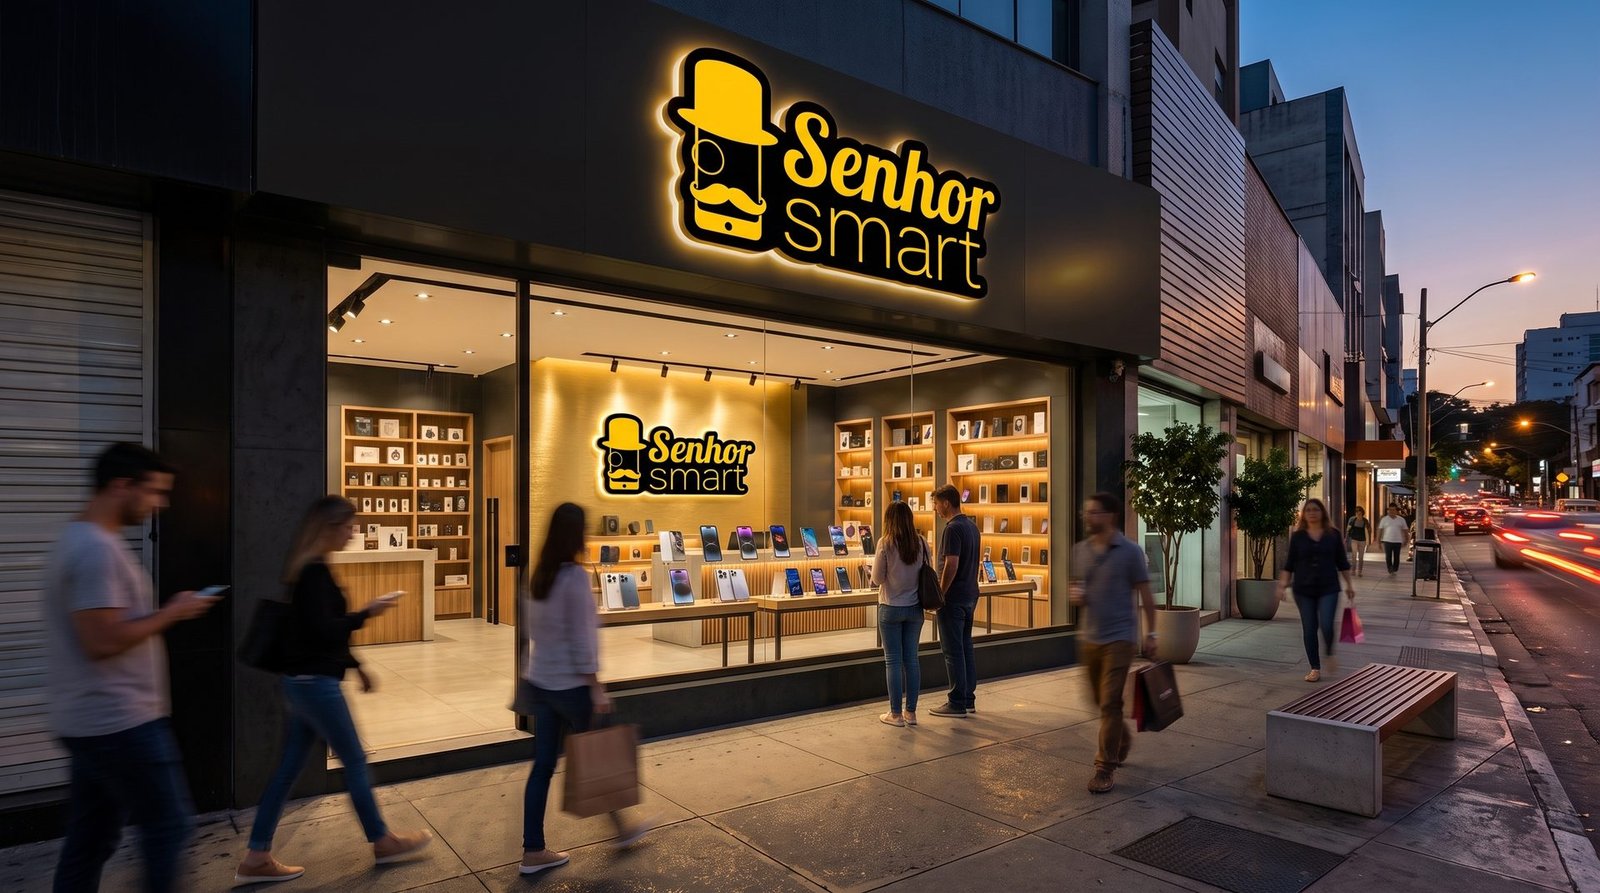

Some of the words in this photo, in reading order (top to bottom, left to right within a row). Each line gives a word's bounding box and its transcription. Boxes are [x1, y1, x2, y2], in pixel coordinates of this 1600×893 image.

[784, 111, 995, 231] Senhor
[784, 198, 981, 289] smart
[649, 430, 752, 464] Senhor
[650, 465, 745, 491] smart
